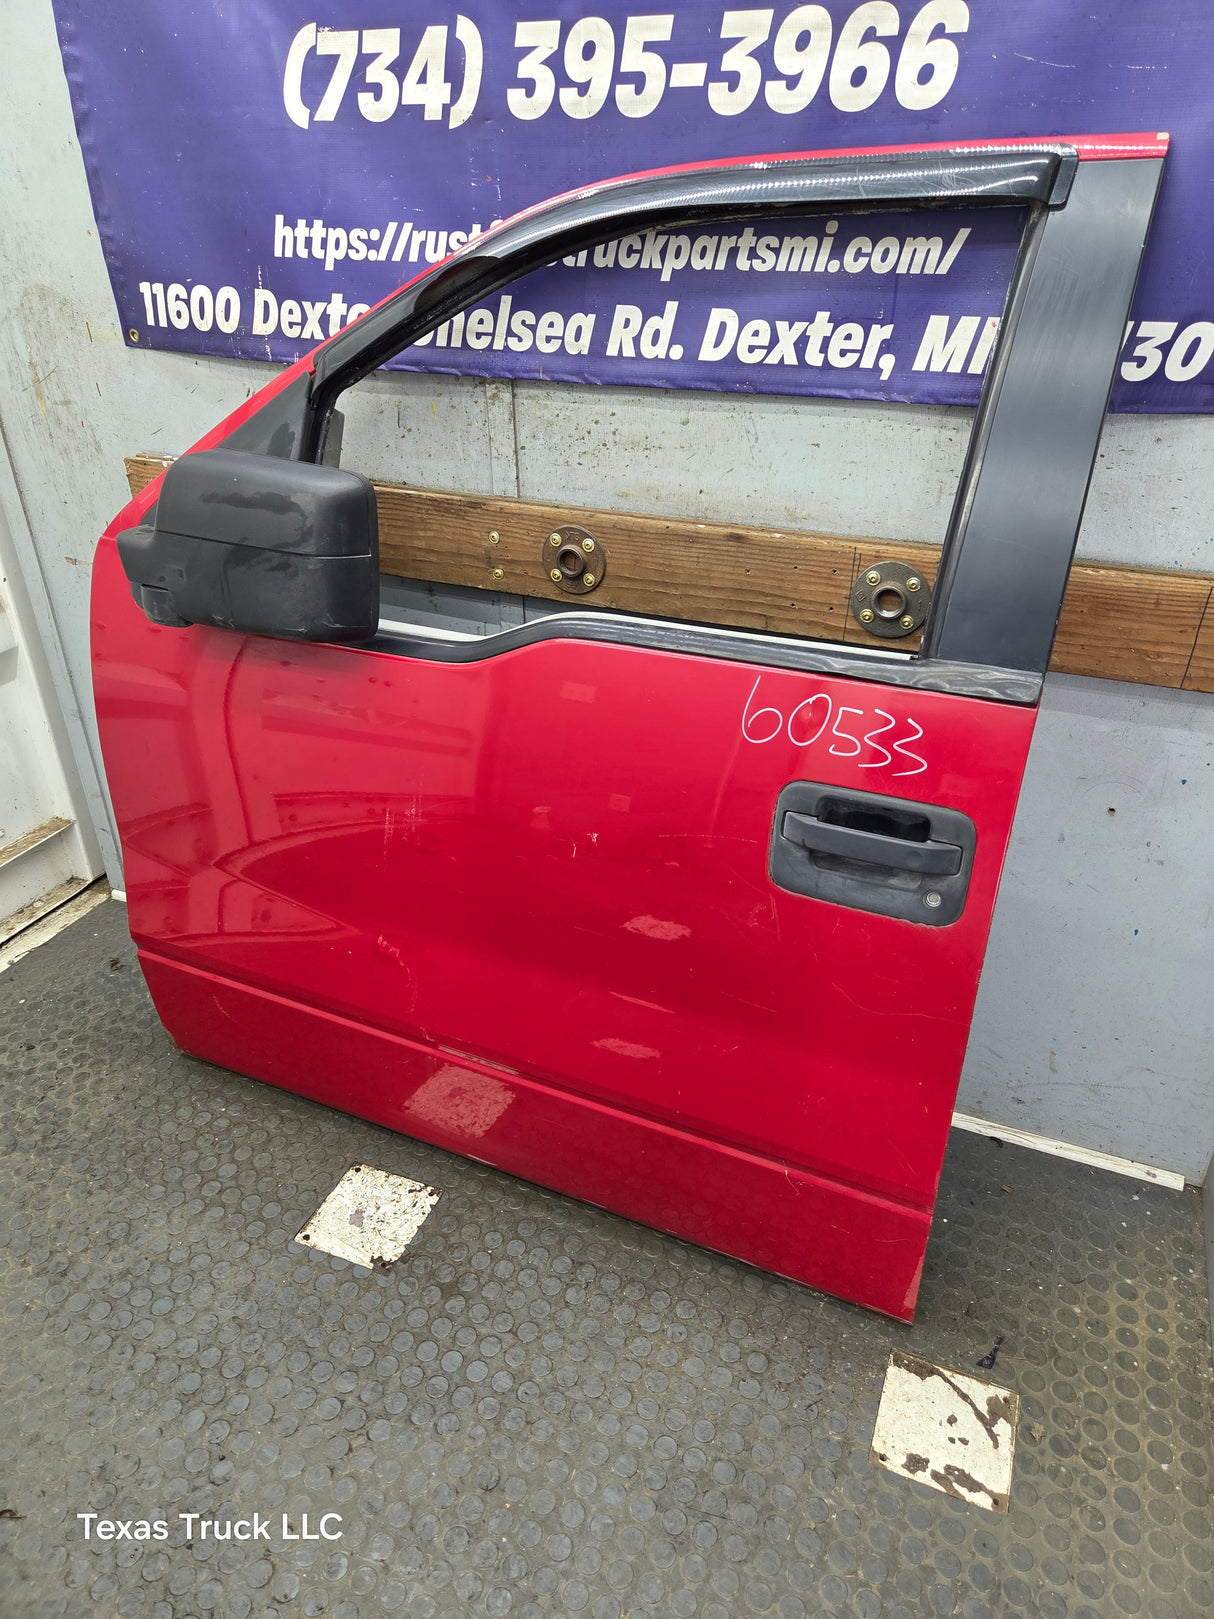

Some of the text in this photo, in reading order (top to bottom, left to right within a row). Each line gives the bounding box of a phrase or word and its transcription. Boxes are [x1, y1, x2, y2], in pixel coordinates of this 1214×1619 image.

[283, 0, 970, 130] (734) 395-3966
[139, 281, 241, 334] 11600
[252, 287, 372, 341] Dext
[412, 294, 596, 356] helsea
[605, 300, 684, 361] Rd.
[698, 307, 895, 381] Dexter,
[742, 675, 928, 777] 60533
